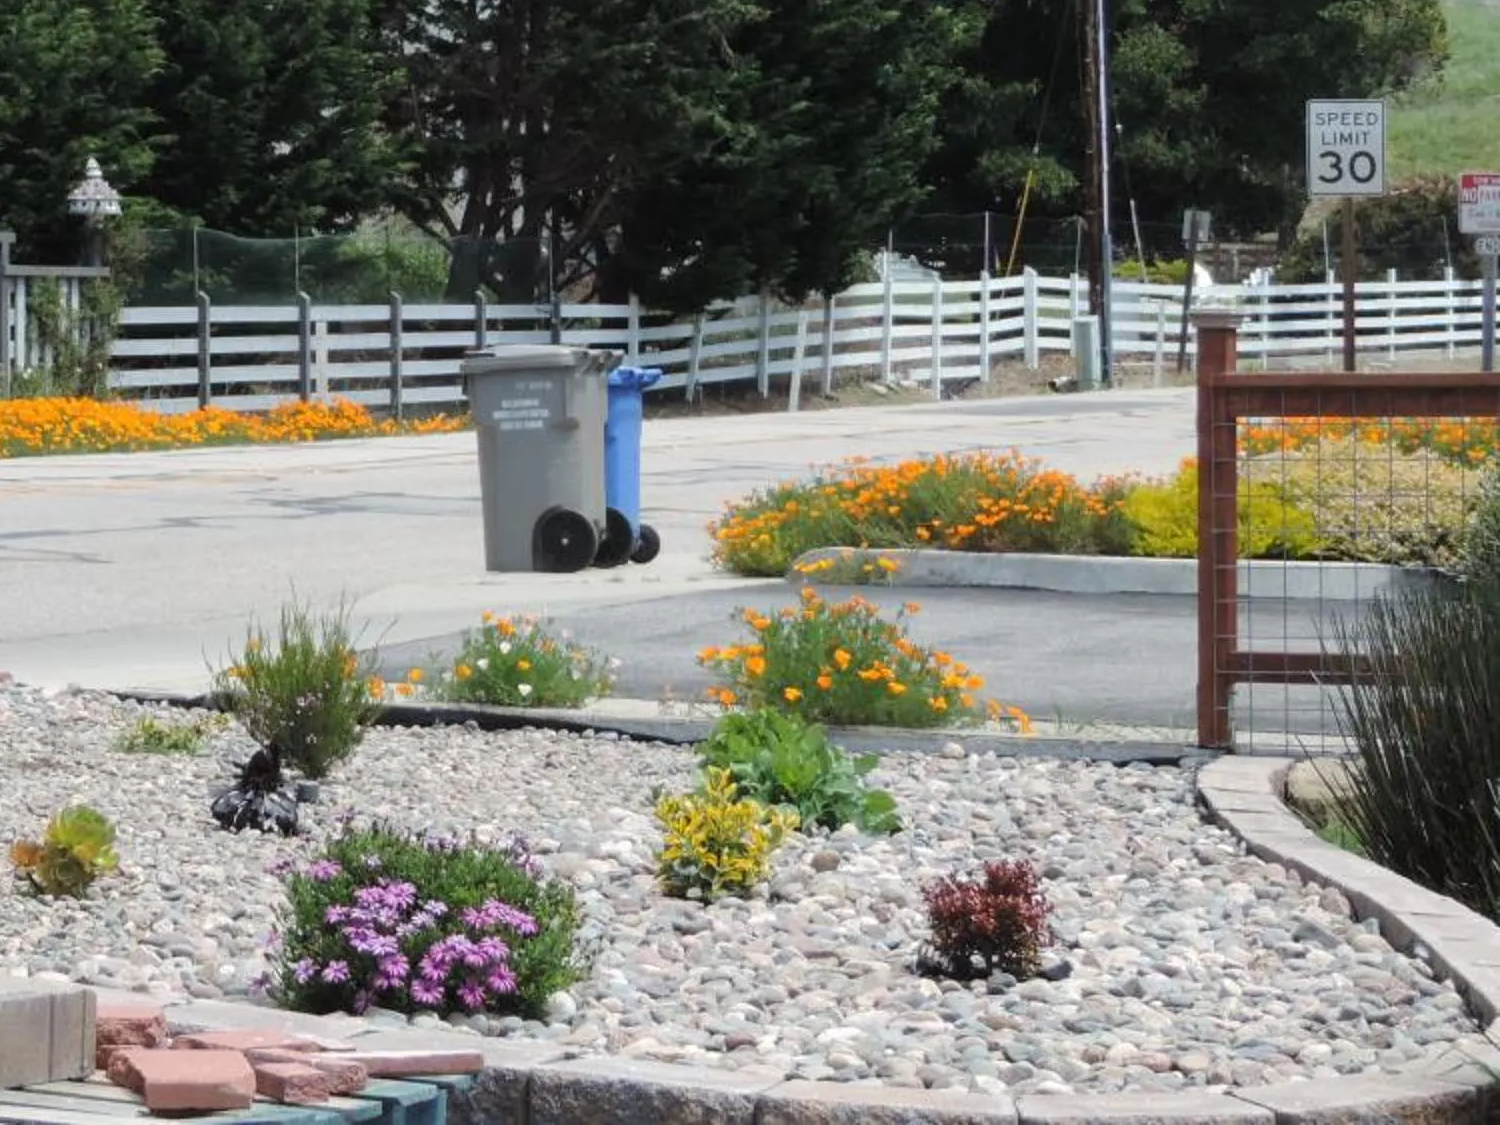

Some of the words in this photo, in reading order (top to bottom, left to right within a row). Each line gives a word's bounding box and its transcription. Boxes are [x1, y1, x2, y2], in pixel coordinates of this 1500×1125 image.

[1315, 112, 1379, 126] SPEED
[1321, 131, 1370, 146] LIMIT
[1318, 151, 1377, 183] 30
